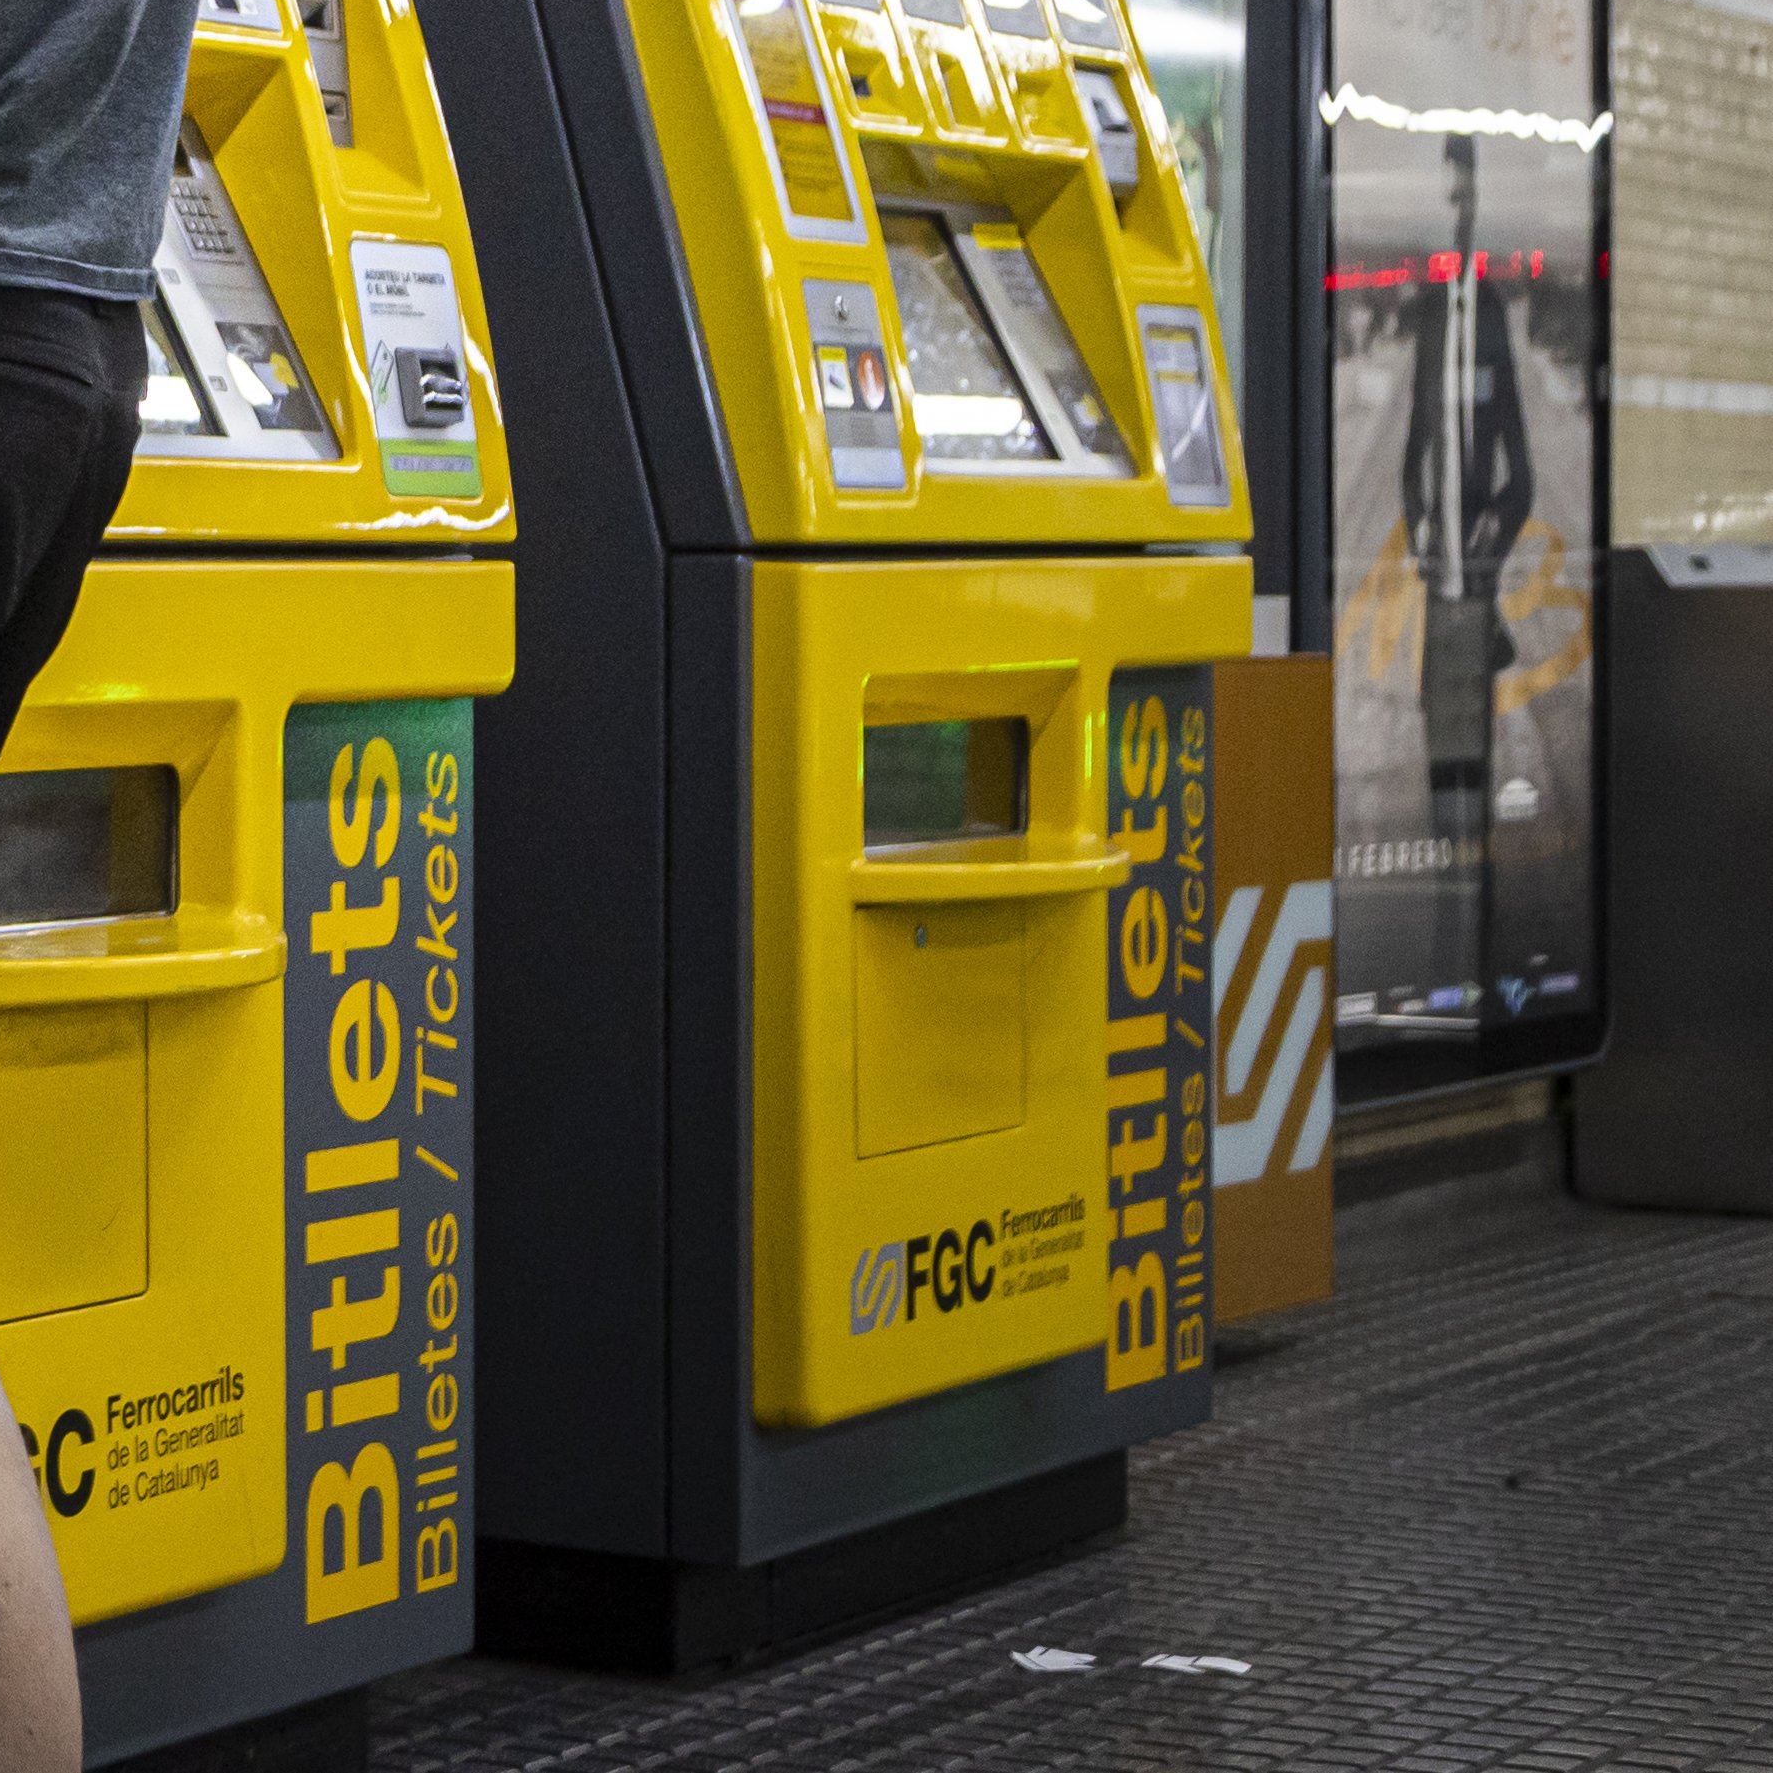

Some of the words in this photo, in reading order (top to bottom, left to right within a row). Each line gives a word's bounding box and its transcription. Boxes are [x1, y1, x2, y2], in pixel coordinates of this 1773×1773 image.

[1175, 706, 1207, 1002] Tickets
[1347, 837, 1453, 878] FEBRERO
[414, 750, 459, 1116] Tickets
[1105, 693, 1169, 1393] Bitllets
[304, 736, 401, 1626] Bitllets
[414, 1144, 459, 1183] /
[1000, 1193, 1086, 1239] Ferrocarrils
[905, 1218, 997, 1324] FGC
[1175, 1073, 1206, 1374] Billetes
[107, 1364, 245, 1434] Ferrocarrils
[107, 1439, 130, 1472] de
[135, 1434, 149, 1464] la
[155, 1408, 245, 1459] Generalitat
[414, 1212, 459, 1595] Billetes
[108, 1480, 131, 1510] de
[135, 1458, 220, 1502] Catalunya
